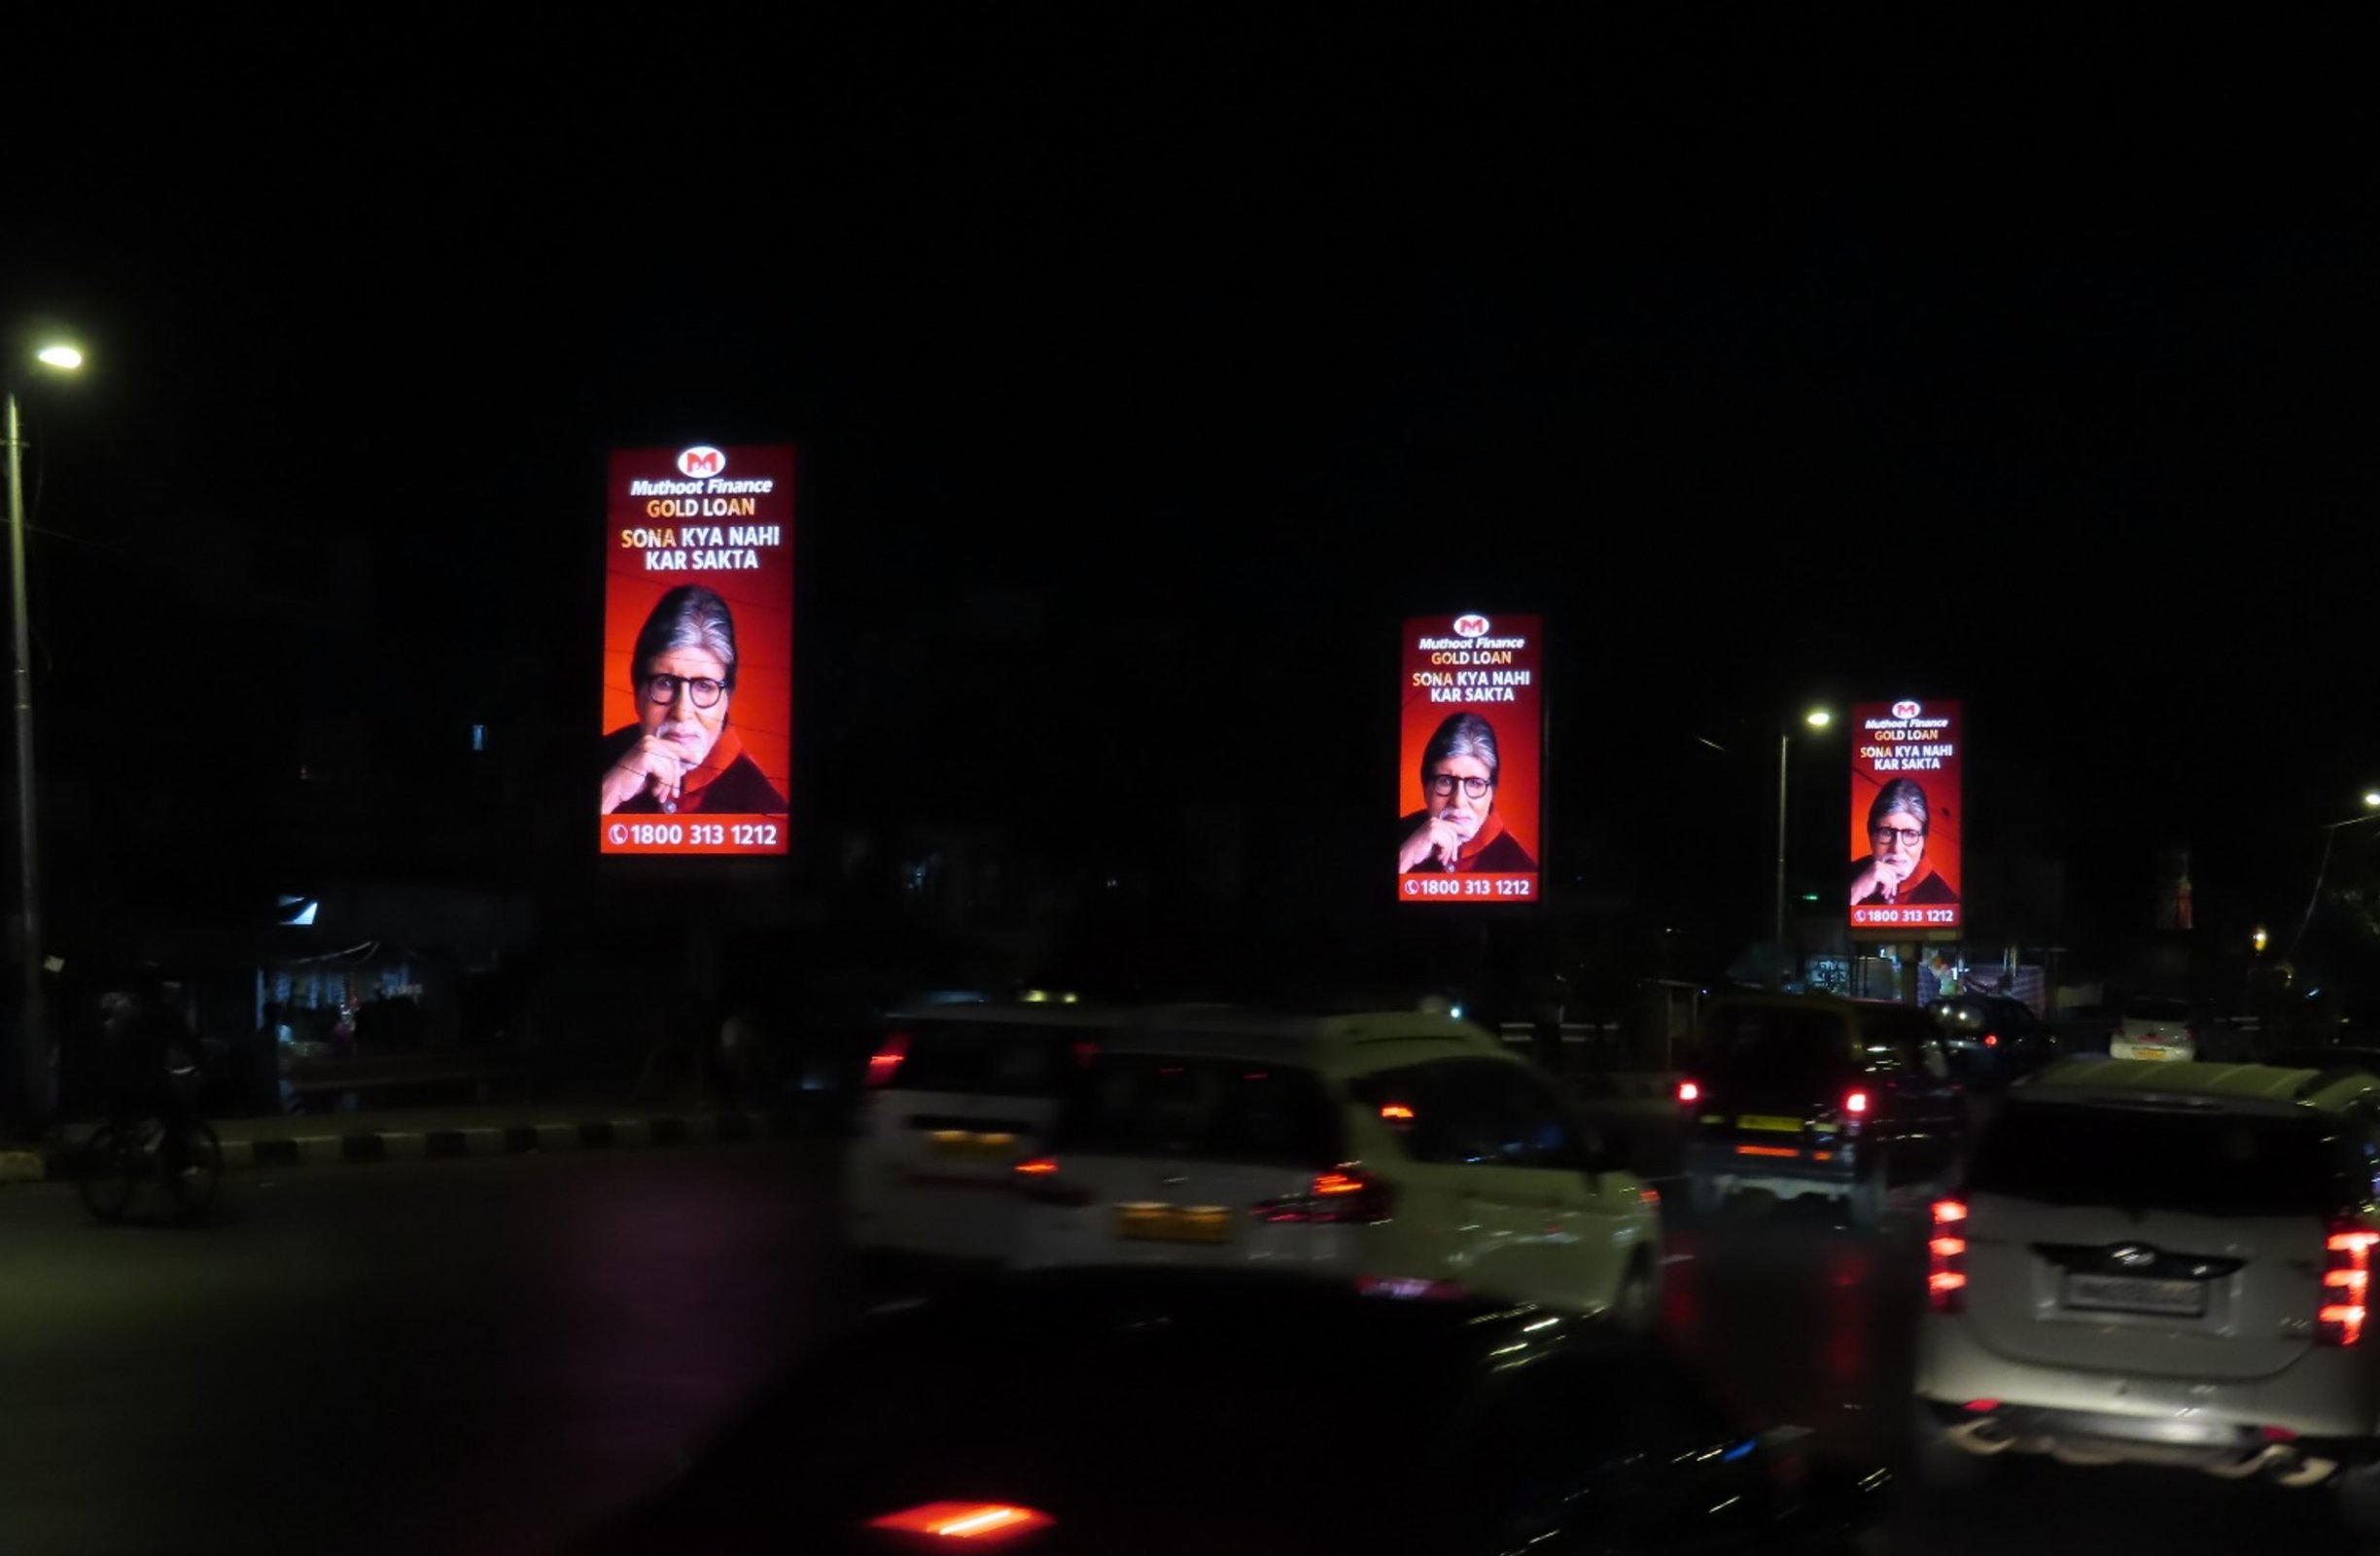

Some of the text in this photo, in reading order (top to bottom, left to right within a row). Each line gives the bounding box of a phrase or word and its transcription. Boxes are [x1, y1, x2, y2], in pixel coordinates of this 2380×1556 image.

[631, 479, 773, 496] Muthoot Finance
[647, 498, 755, 517] GOLD LOAN
[621, 526, 780, 548] SONA KYA NAHI
[646, 549, 759, 570] KAR SAKTA
[1418, 638, 1524, 650] Muthoot Finance
[1431, 652, 1512, 664] GOLD LOAN
[1413, 671, 1530, 687] SONA KYA NAHI
[1431, 688, 1515, 702] KAR SAKTA
[1874, 729, 1939, 741] GOLD LOAN
[1860, 745, 1953, 758] SONA KYA NAHI
[1874, 759, 1941, 770] KAR SAKTA
[632, 825, 777, 844] 1800 313 1212
[1421, 880, 1529, 895] 1800 313 1212
[1869, 910, 1953, 922] 1800 313 1212
